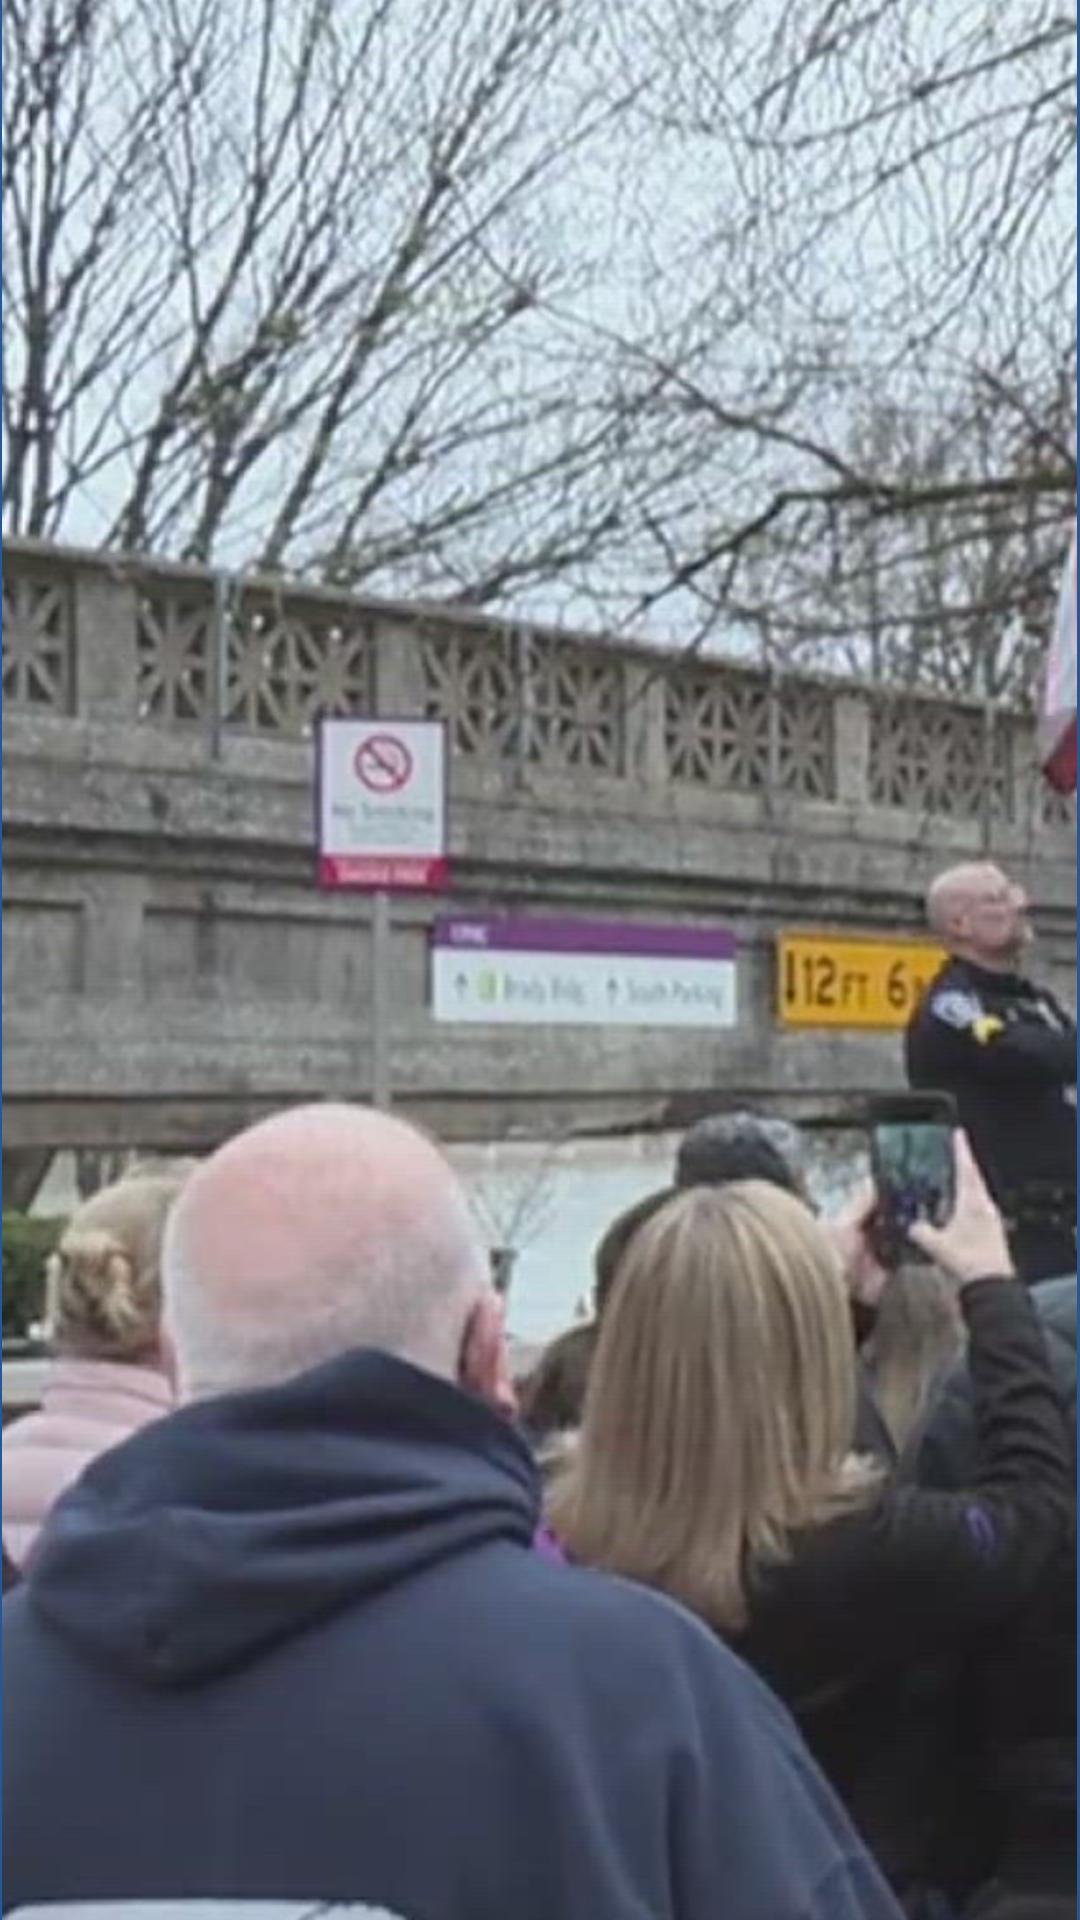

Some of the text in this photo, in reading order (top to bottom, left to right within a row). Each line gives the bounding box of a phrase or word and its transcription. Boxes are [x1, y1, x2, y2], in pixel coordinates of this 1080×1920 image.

[803, 957, 908, 1010] 12 FT 6
